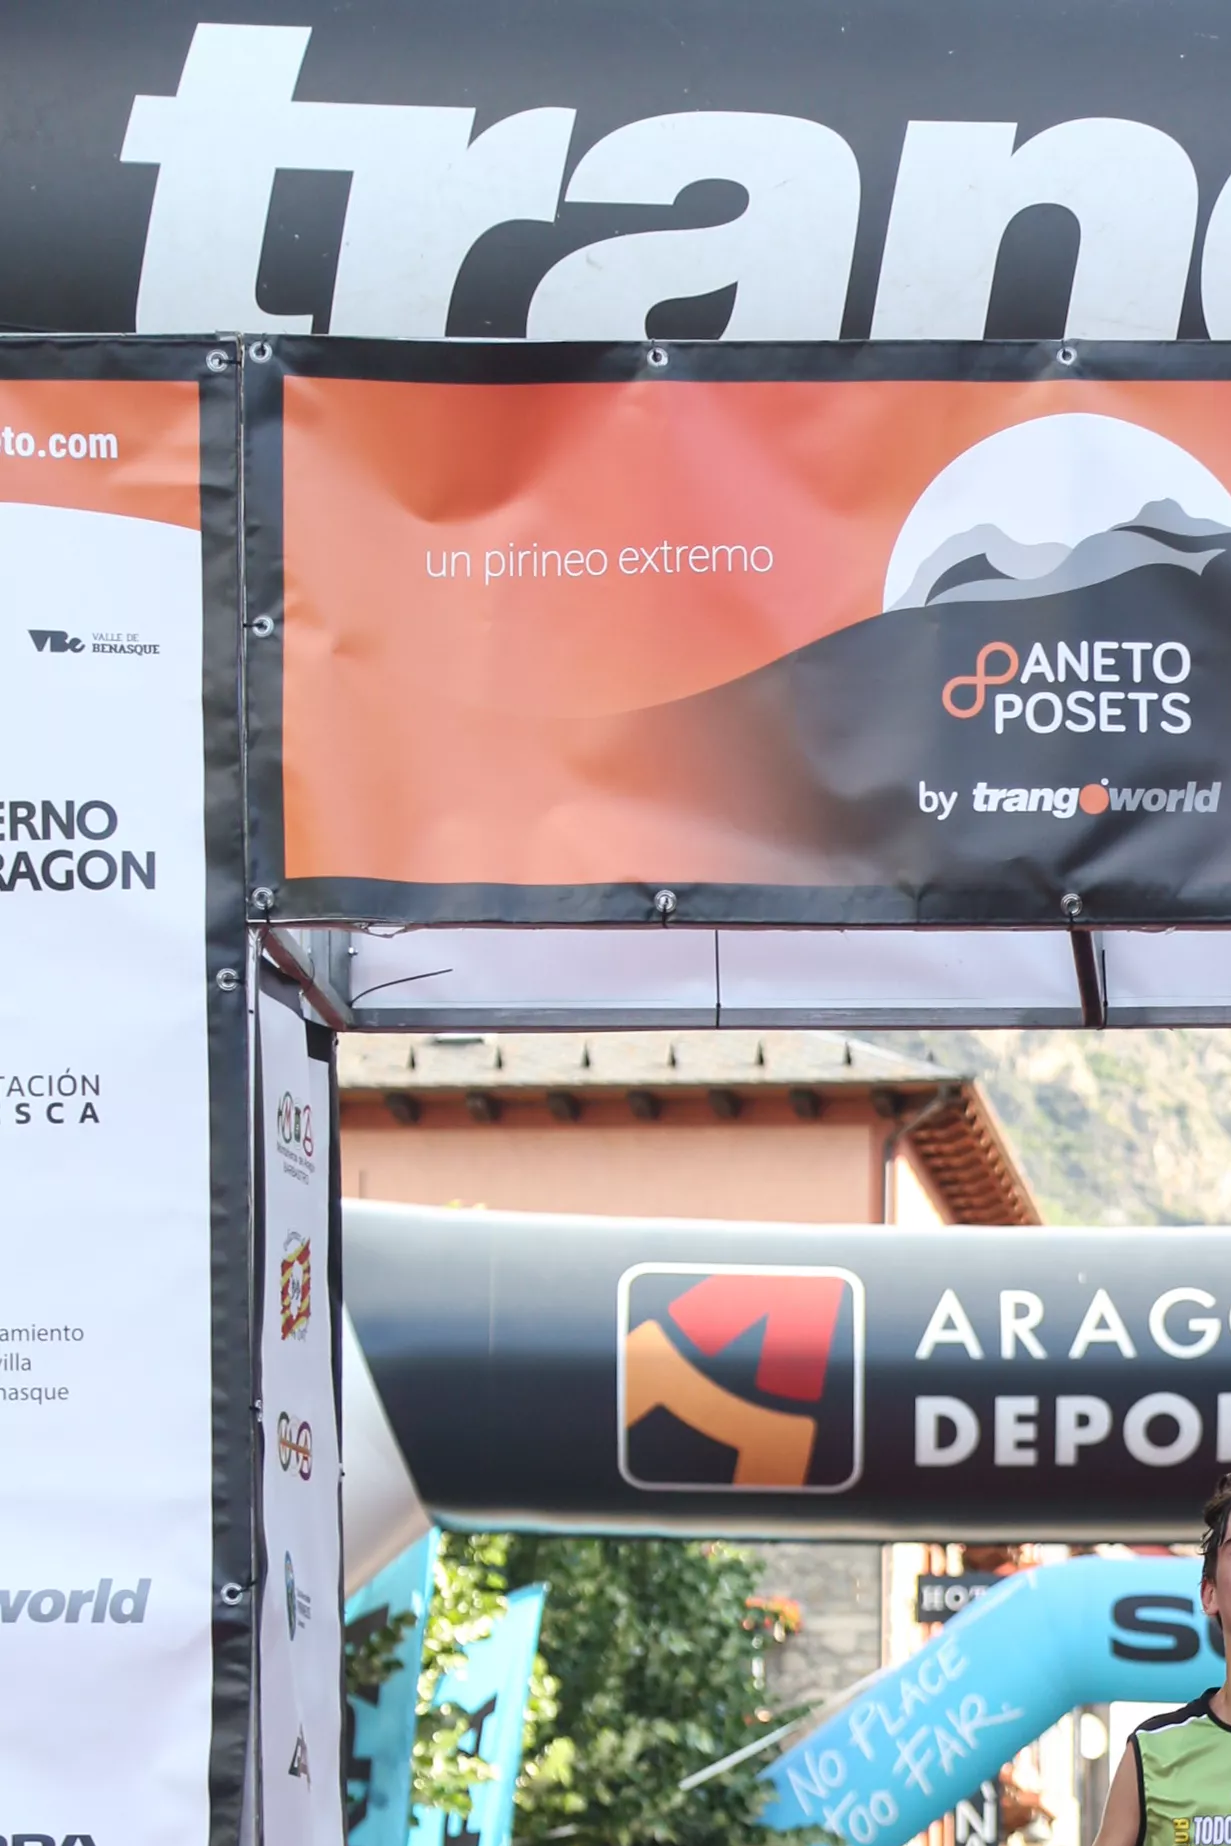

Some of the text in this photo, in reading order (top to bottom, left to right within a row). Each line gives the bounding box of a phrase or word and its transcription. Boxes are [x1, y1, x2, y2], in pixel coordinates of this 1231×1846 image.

[0, 426, 119, 459] to.com
[427, 541, 774, 584] un pirineo extremo
[92, 633, 140, 642] VALLE DE
[92, 643, 160, 656] BENASQUE
[1020, 640, 1191, 684] ANETO
[994, 691, 1192, 734] POSETS
[918, 779, 1222, 820] by trangoworld
[0, 1068, 101, 1098] ACIÓN
[785, 1636, 970, 1817] NO PLACE
